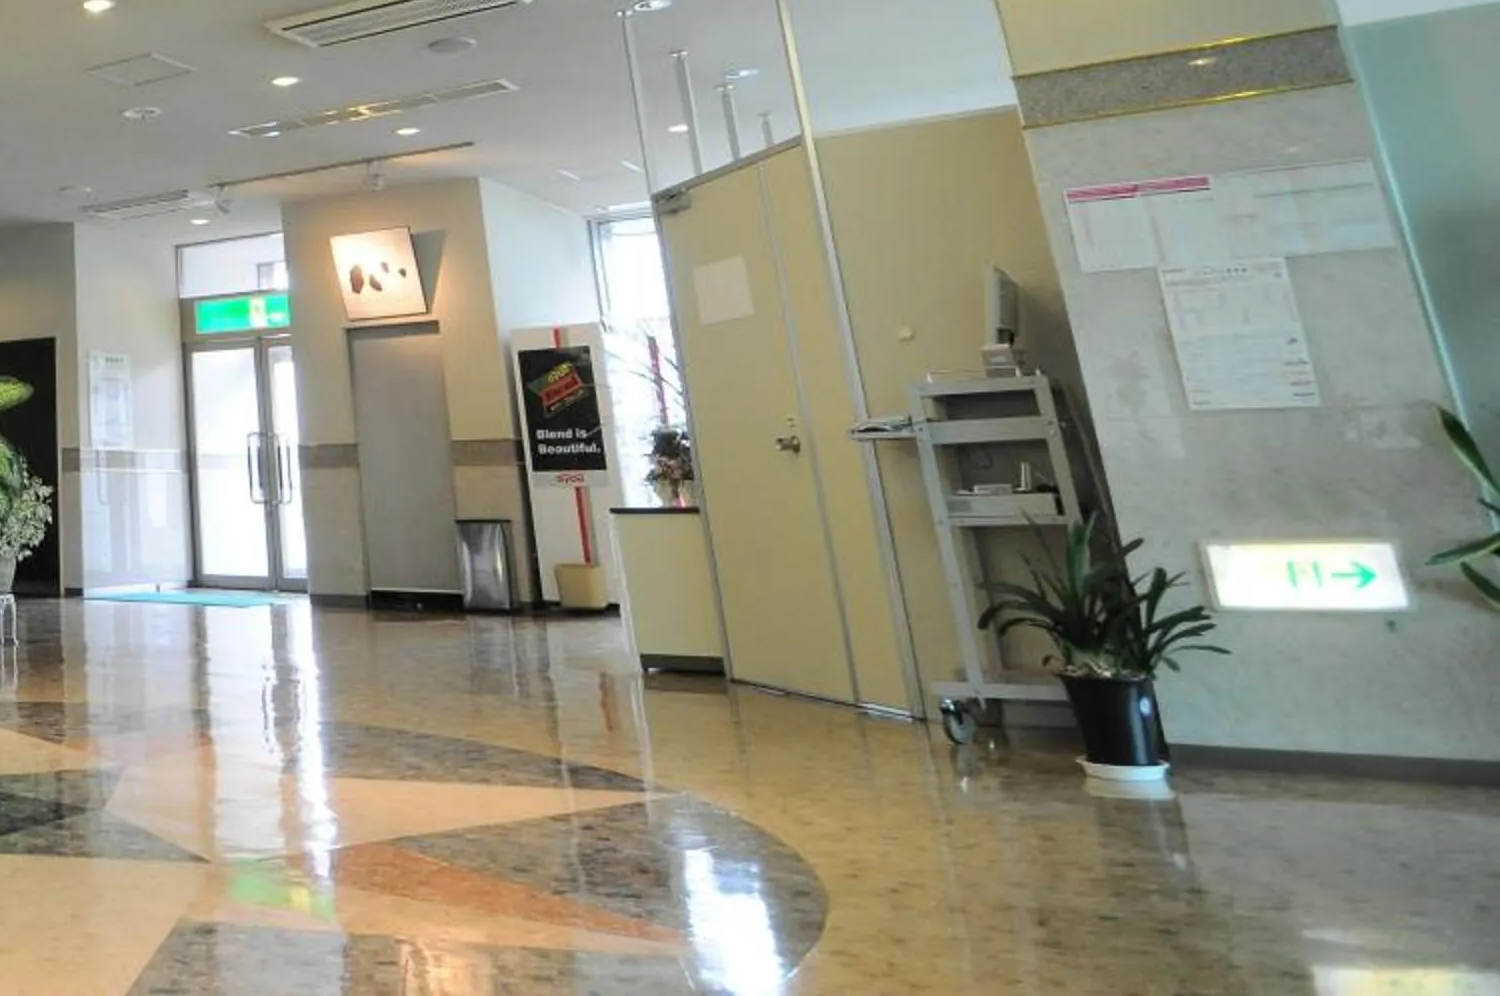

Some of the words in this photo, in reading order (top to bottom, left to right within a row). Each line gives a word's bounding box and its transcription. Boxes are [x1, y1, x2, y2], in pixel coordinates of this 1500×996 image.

[536, 427, 573, 440] Blend
[575, 427, 587, 439] is
[538, 441, 601, 455] Beautiful.
